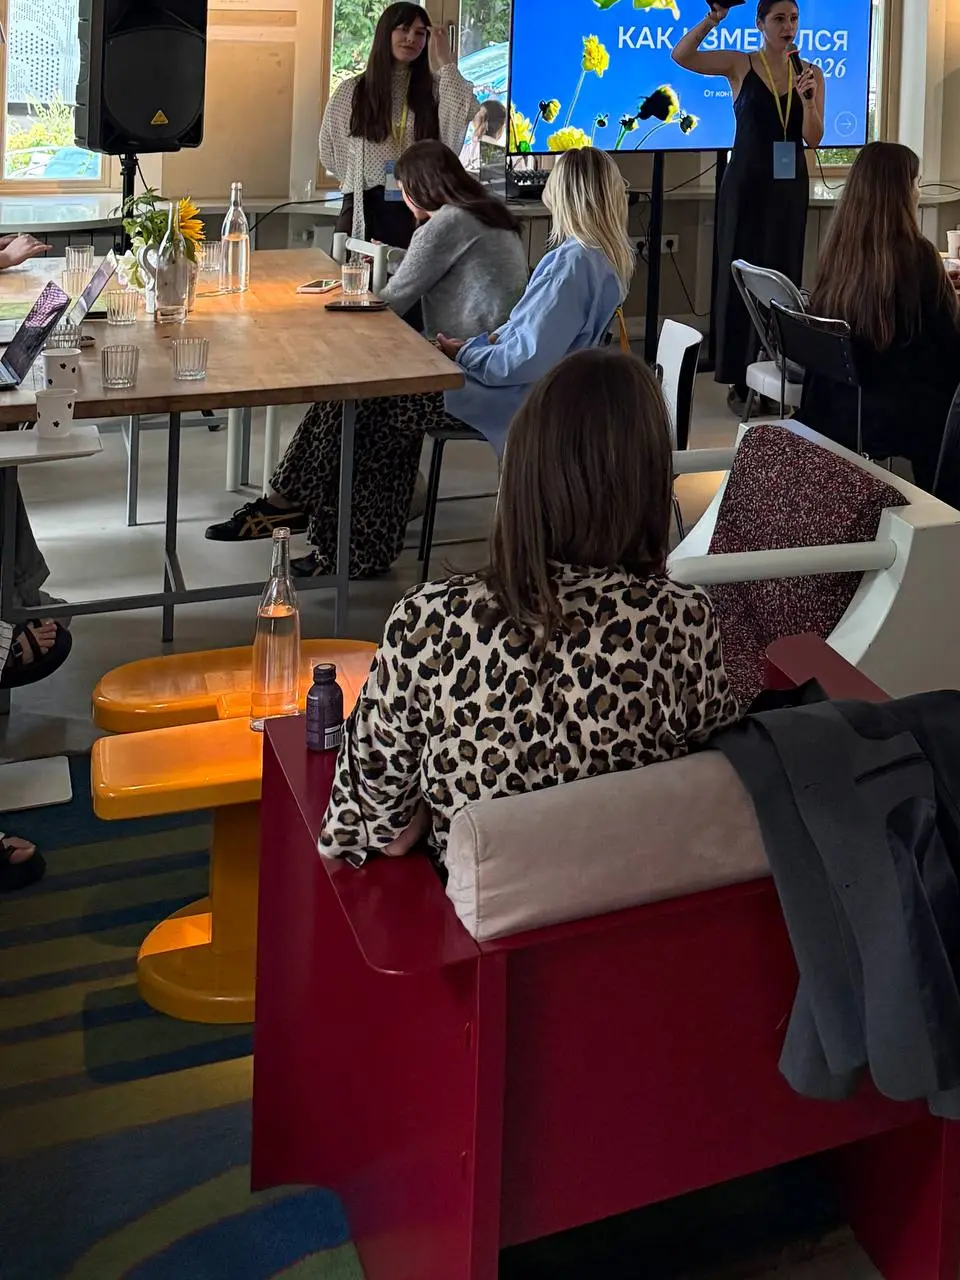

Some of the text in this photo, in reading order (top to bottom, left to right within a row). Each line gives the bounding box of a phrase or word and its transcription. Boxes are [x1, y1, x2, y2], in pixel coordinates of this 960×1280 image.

[618, 26, 848, 51] КАК ЗМЕЛСЯ
[703, 89, 714, 98] От
